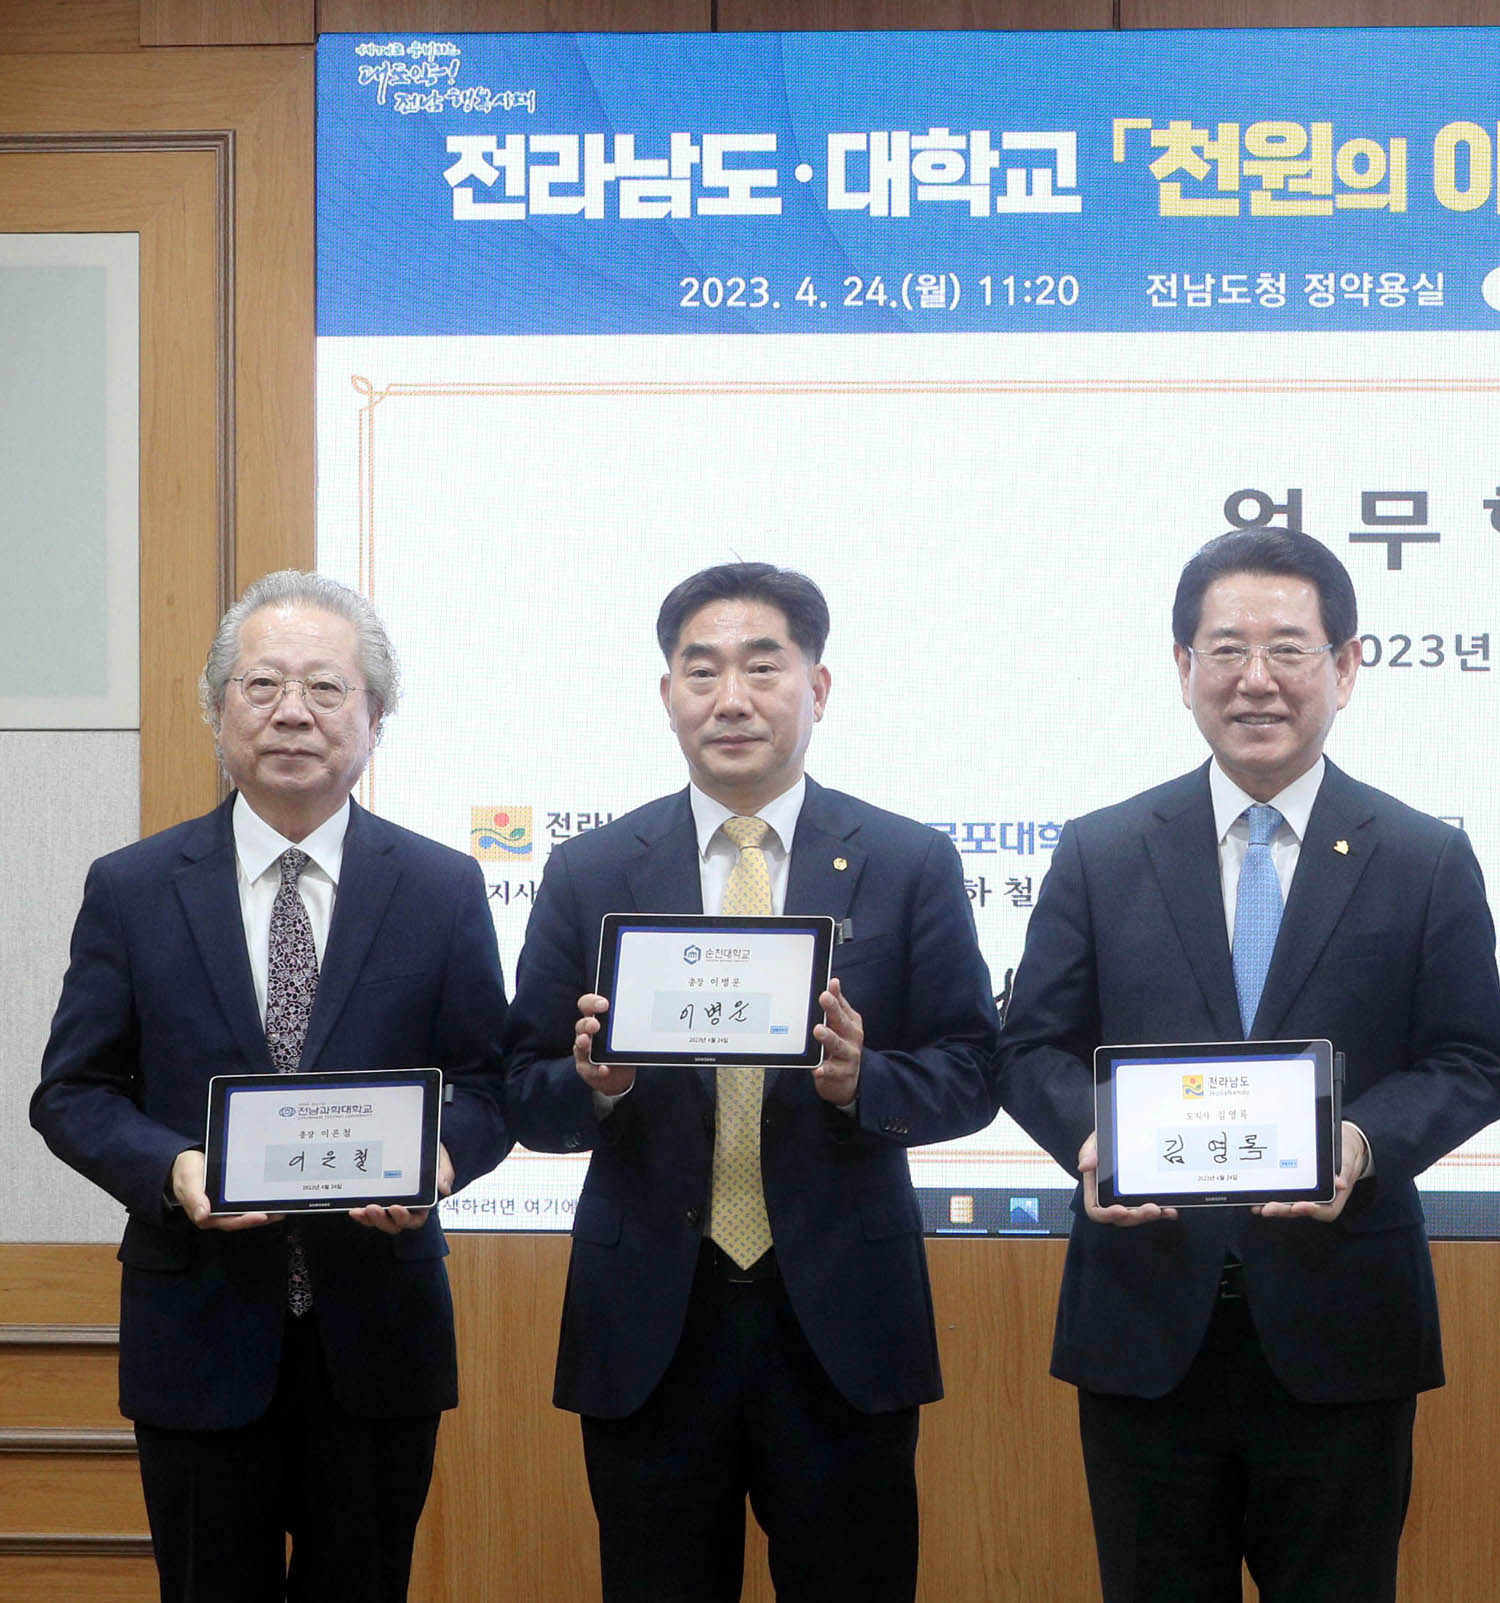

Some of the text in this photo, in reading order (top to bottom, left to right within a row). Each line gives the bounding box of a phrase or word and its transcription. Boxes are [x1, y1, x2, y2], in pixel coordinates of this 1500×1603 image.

[679, 271, 1080, 312] 2023. 4. 24.(월) 11:20
[1145, 270, 1445, 308] 전남도청 정약용실
[704, 948, 751, 960] 순천대학교
[1208, 1075, 1250, 1089] 전라남도
[298, 1104, 373, 1117] 전남과학대학교
